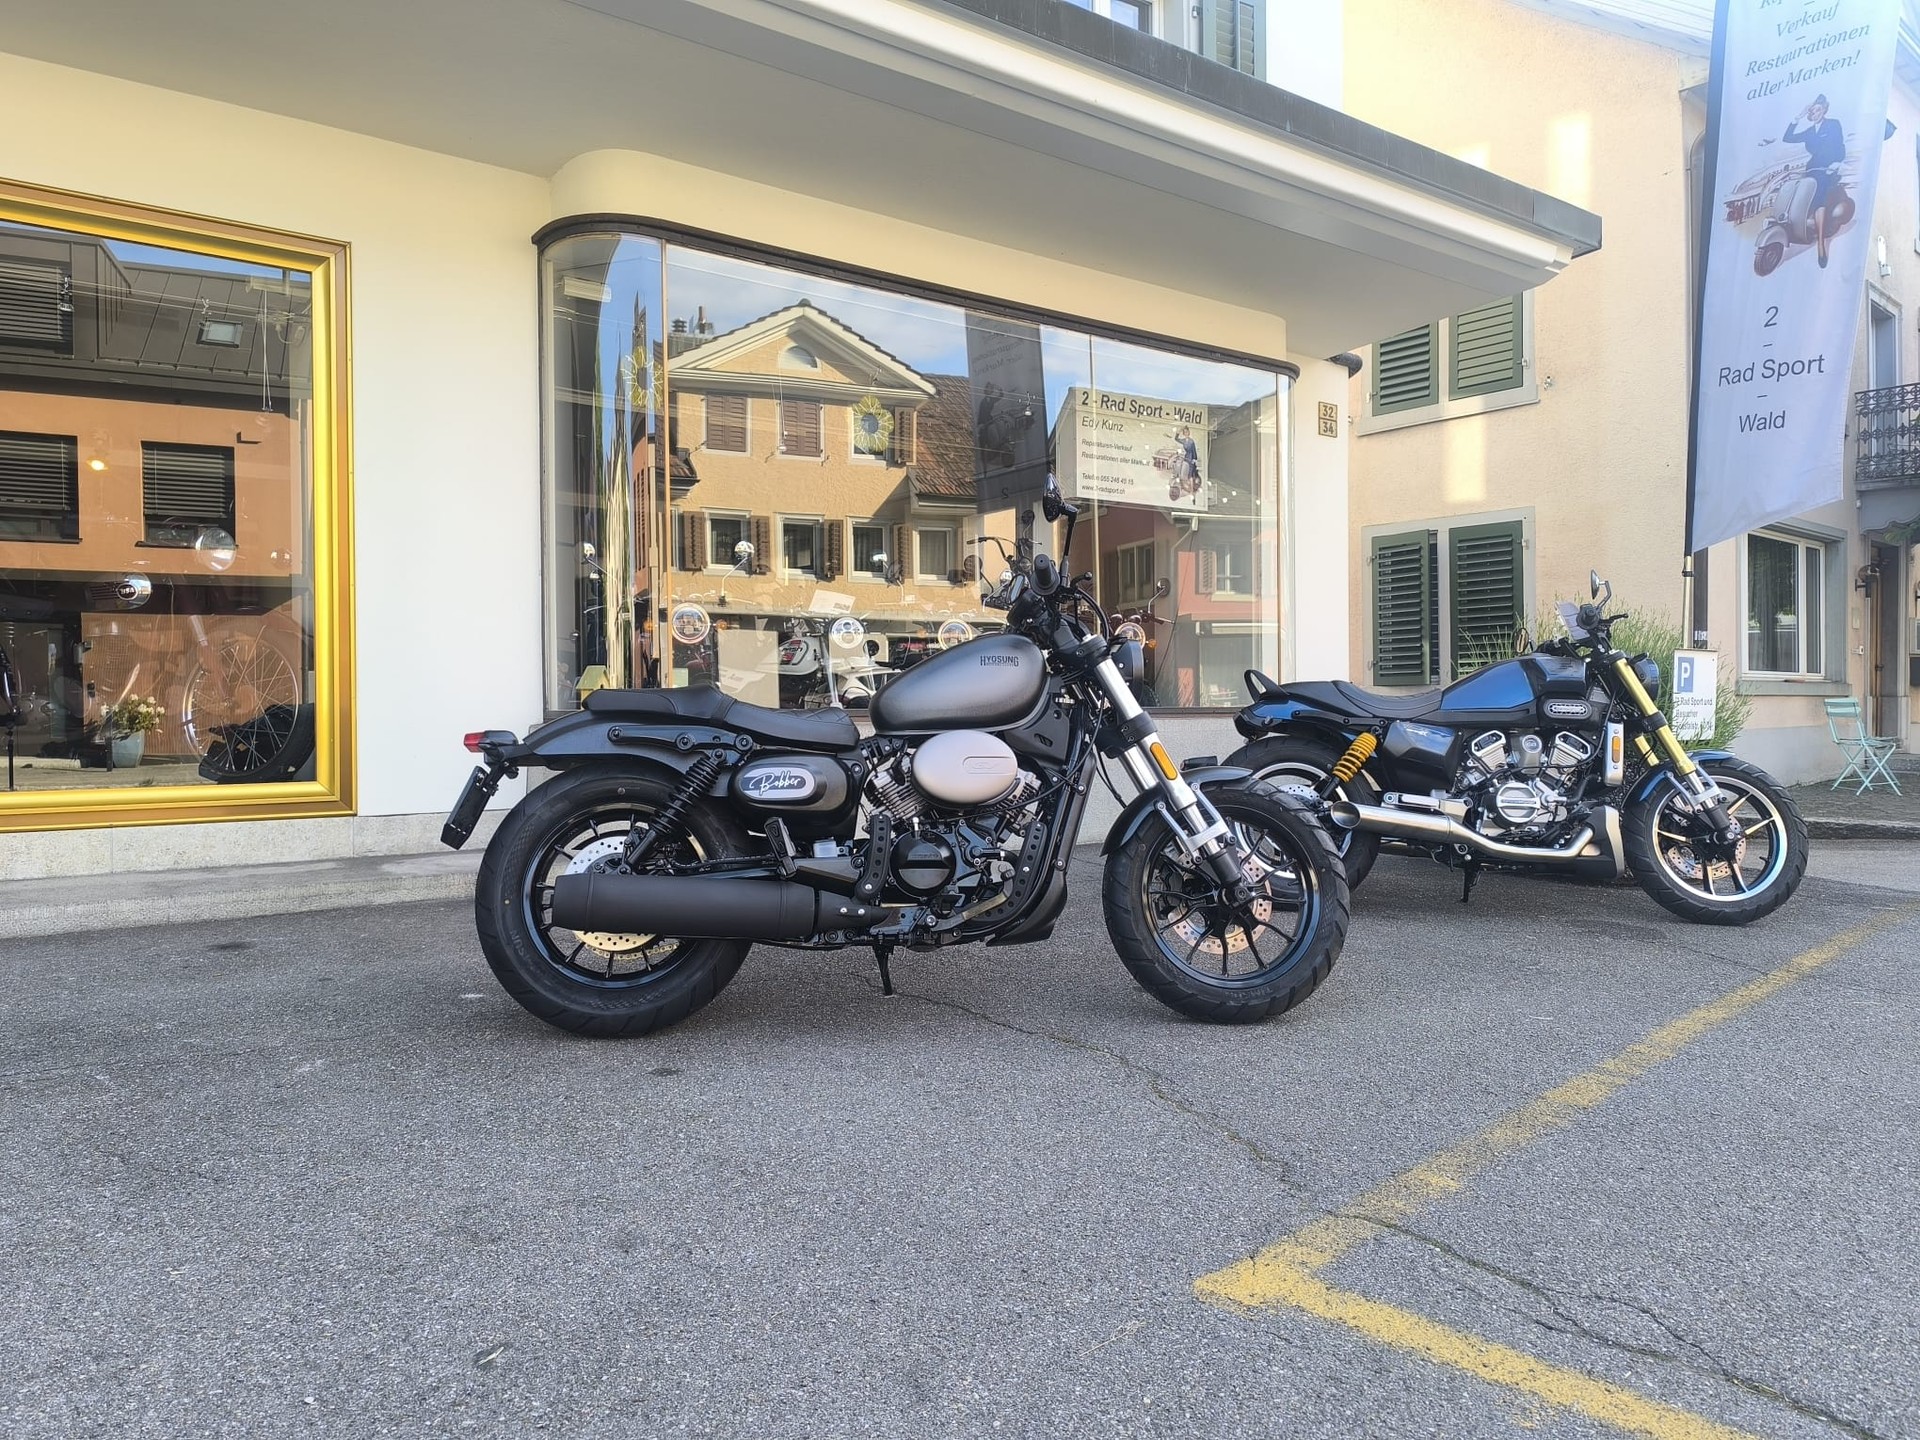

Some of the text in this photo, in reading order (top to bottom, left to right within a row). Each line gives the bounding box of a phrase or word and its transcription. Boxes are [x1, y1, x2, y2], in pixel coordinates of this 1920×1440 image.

[1777, 0, 1840, 37] Verkauf
[1744, 24, 1871, 77] Restaurationen
[1746, 49, 1862, 101] aller Marken!
[1763, 305, 1779, 328] 2
[1718, 354, 1825, 387] Rad Sport
[1081, 390, 1090, 406] 2
[1100, 394, 1126, 412] Rad
[1129, 399, 1163, 418] Sport
[1174, 406, 1203, 425] Wald
[1322, 404, 1334, 419] 32
[1101, 418, 1124, 432] Kunz
[1322, 421, 1334, 435] 34
[1738, 410, 1786, 433] Wald
[1082, 472, 1100, 482] Telefn
[980, 655, 1019, 667] HYOSUNG
[1681, 662, 1691, 688] P
[748, 769, 802, 797] Bobber
